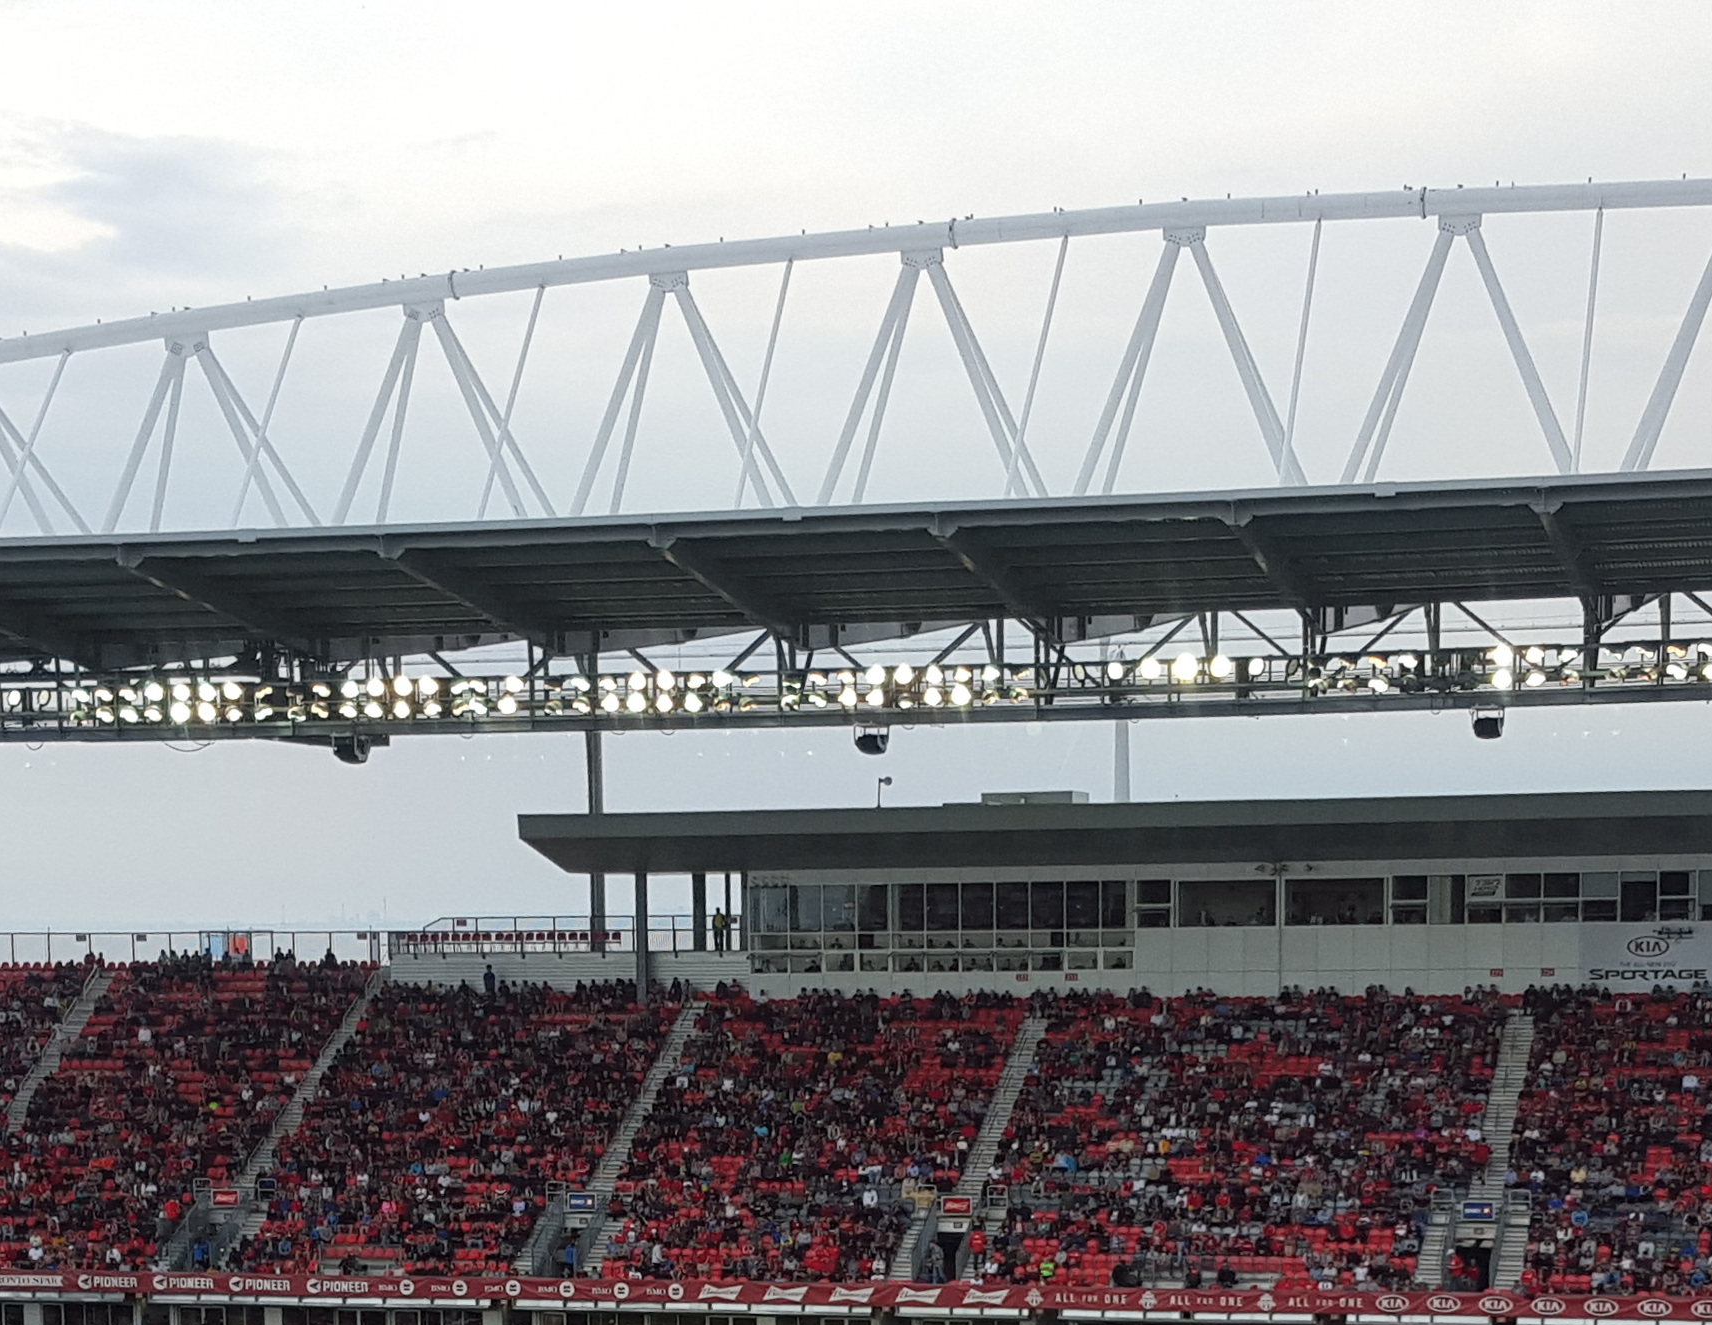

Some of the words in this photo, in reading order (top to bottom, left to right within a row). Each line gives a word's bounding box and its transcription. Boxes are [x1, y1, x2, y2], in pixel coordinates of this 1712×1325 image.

[1634, 941, 1663, 952] KIA
[1588, 968, 1707, 981] SPORTAGE
[93, 1275, 138, 1288] PIONEER
[168, 1277, 214, 1290] PIONEER
[244, 1278, 291, 1292] PIONEER
[322, 1279, 369, 1293] PIONEER
[1055, 1293, 1075, 1304] ALL
[1104, 1293, 1127, 1305] ONE
[1170, 1294, 1190, 1306] ALL
[1220, 1295, 1243, 1307] ONE
[1288, 1296, 1309, 1307] ALL
[1339, 1297, 1363, 1308] ONE
[1381, 1298, 1403, 1309] KIA
[1433, 1299, 1455, 1309] KIA
[1486, 1300, 1507, 1311] KIA
[1537, 1301, 1559, 1312] KIA
[1590, 1302, 1613, 1312] KIA
[1643, 1303, 1666, 1313] KIA
